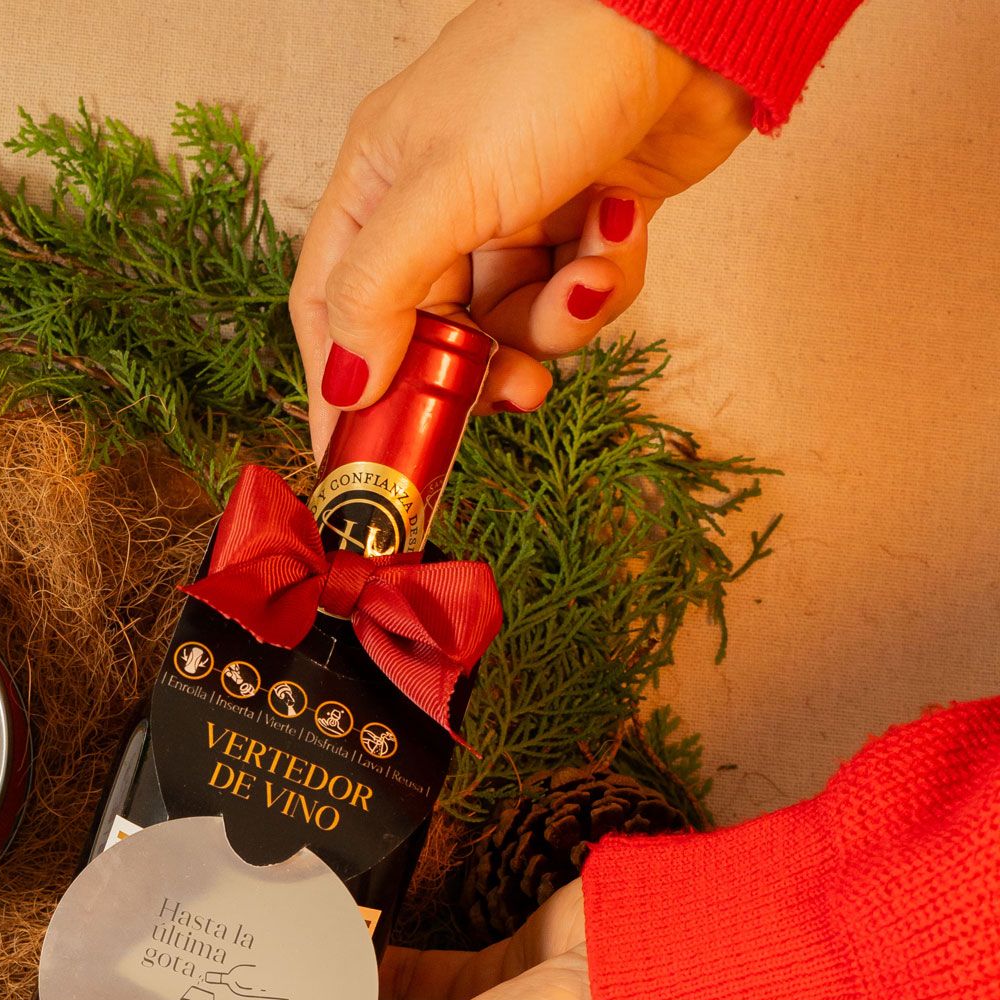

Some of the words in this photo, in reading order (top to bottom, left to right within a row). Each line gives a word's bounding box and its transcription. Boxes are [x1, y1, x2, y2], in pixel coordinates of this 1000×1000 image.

[317, 490, 327, 501] Y
[330, 472, 414, 514] CONFIANZA
[167, 675, 207, 701] Enrolla
[215, 695, 255, 720] Inserta
[265, 716, 297, 736] Vierte
[305, 731, 349, 759] Disfruta
[357, 753, 384, 775] Lava
[391, 767, 424, 793] Reusa
[206, 721, 374, 812] VERTEDOR
[208, 761, 257, 800] DE
[264, 780, 340, 831] VINO
[151, 922, 228, 965] última
[158, 897, 228, 941] Hasta
[232, 924, 256, 950] la
[141, 947, 197, 978] gota
